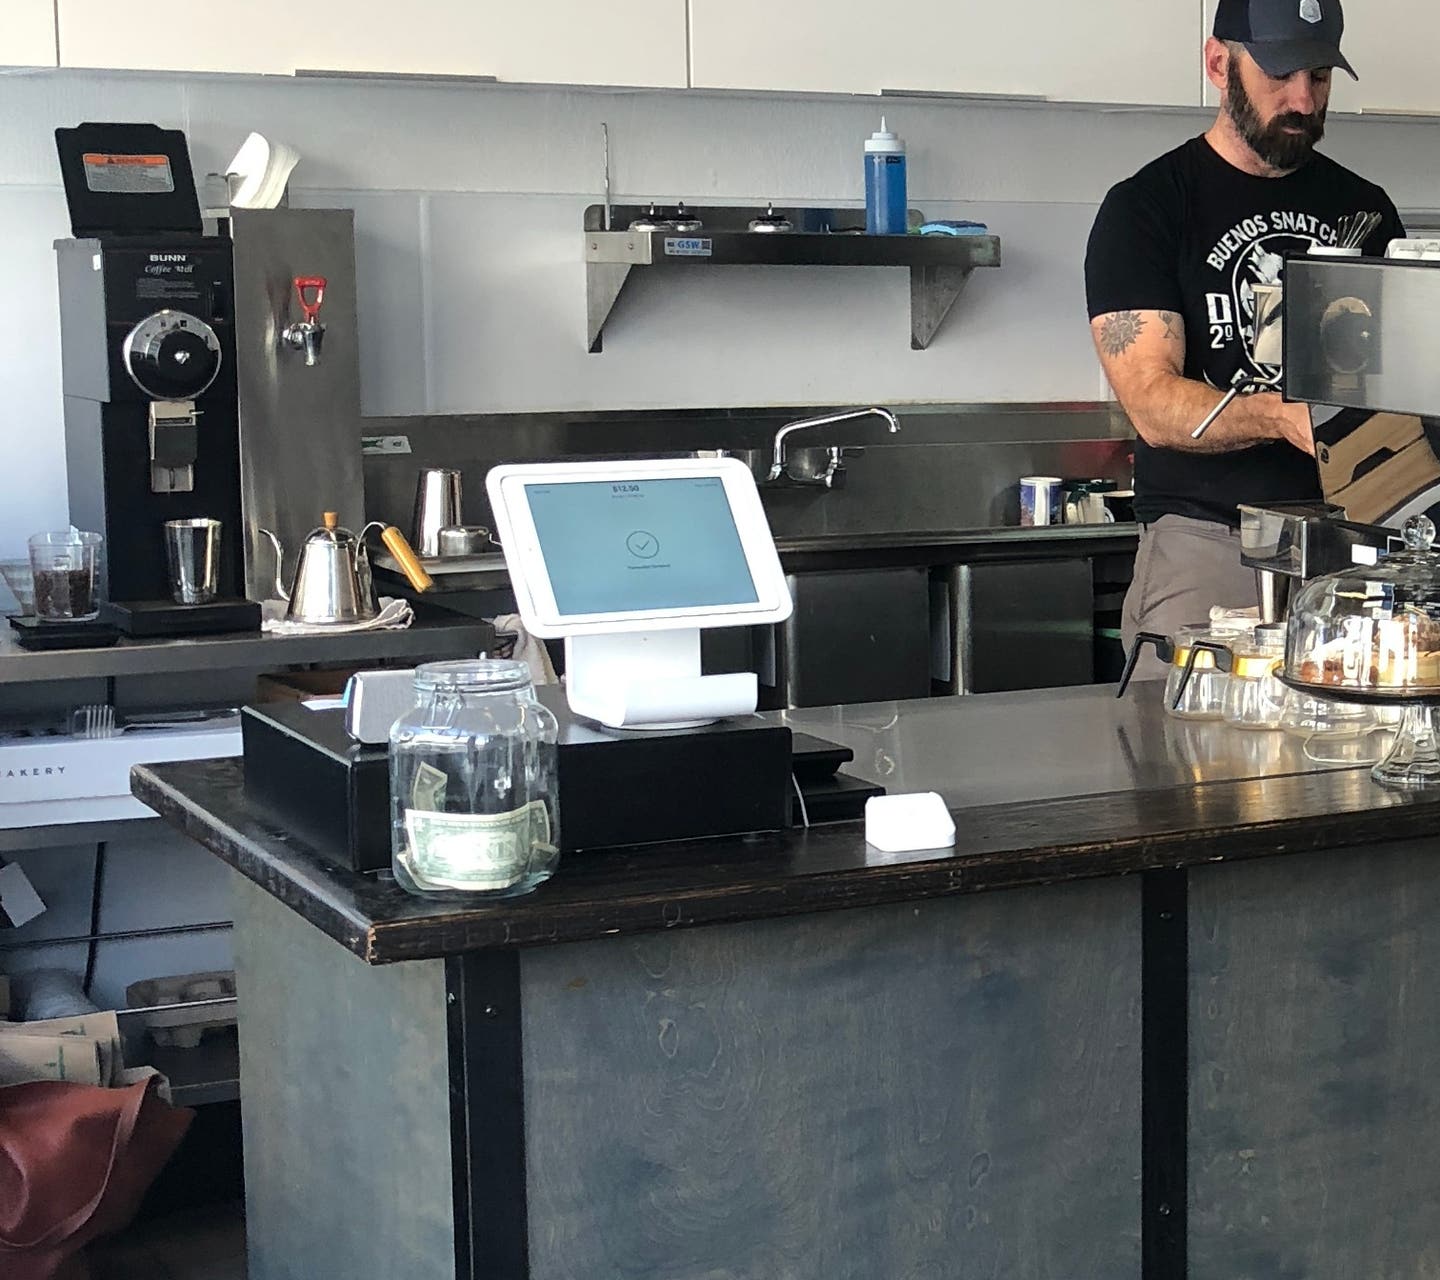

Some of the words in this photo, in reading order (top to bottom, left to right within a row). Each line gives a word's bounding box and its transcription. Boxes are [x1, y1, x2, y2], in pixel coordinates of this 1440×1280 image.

[678, 241, 700, 249] GSW
[1206, 214, 1268, 271] BUENOS
[145, 265, 171, 273] Coffee
[0, 767, 65, 776] AKERY
